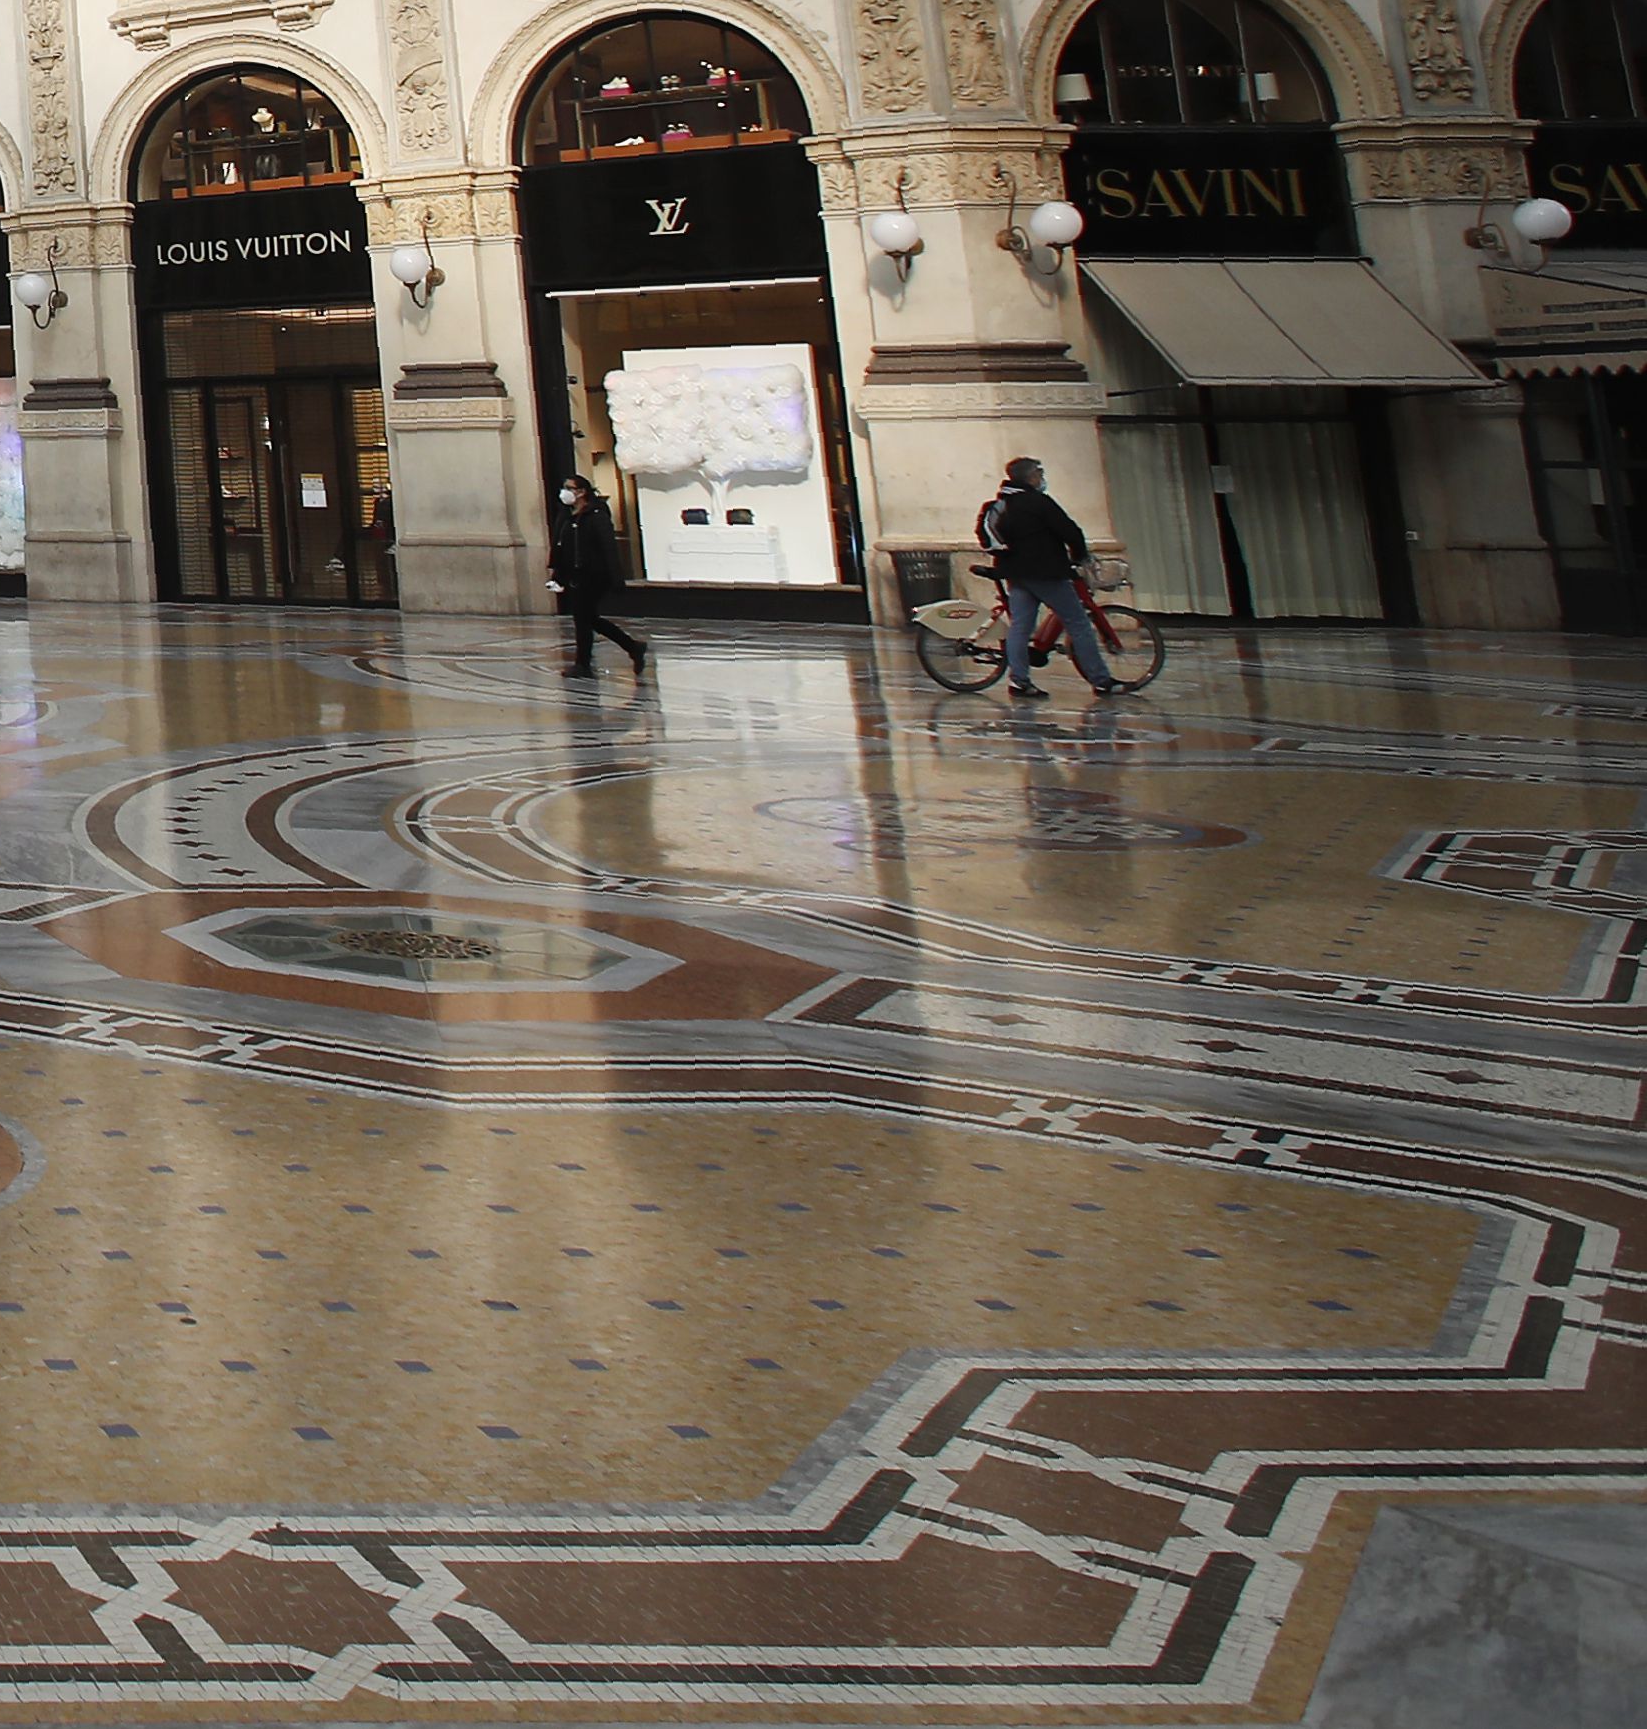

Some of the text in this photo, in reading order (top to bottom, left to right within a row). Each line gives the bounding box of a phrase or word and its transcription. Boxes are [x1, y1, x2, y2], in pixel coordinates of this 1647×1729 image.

[1096, 168, 1309, 219] SAVINI
[156, 229, 352, 266] LOUIS VUITTON
